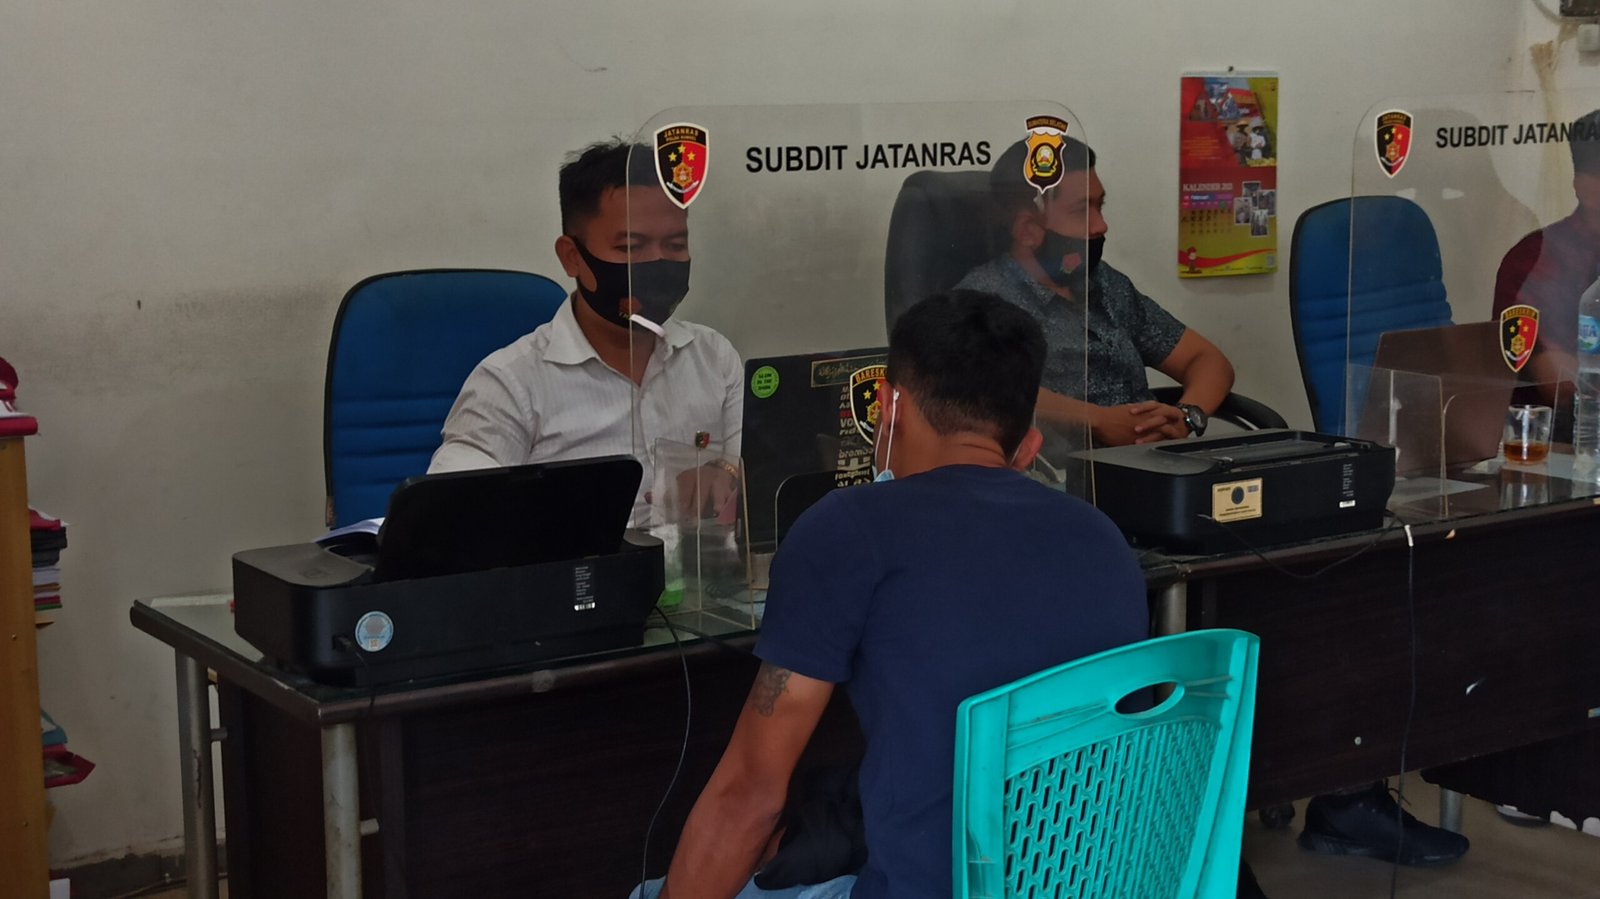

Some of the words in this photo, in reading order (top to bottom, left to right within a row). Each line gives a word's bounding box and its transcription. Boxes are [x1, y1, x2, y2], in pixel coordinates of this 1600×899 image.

[1436, 125, 1509, 148] SUBDIT
[1513, 121, 1600, 145] JATANRA
[746, 145, 848, 173] SUBDIT
[856, 140, 992, 170] JATANRAS
[854, 366, 886, 384] BARESK
